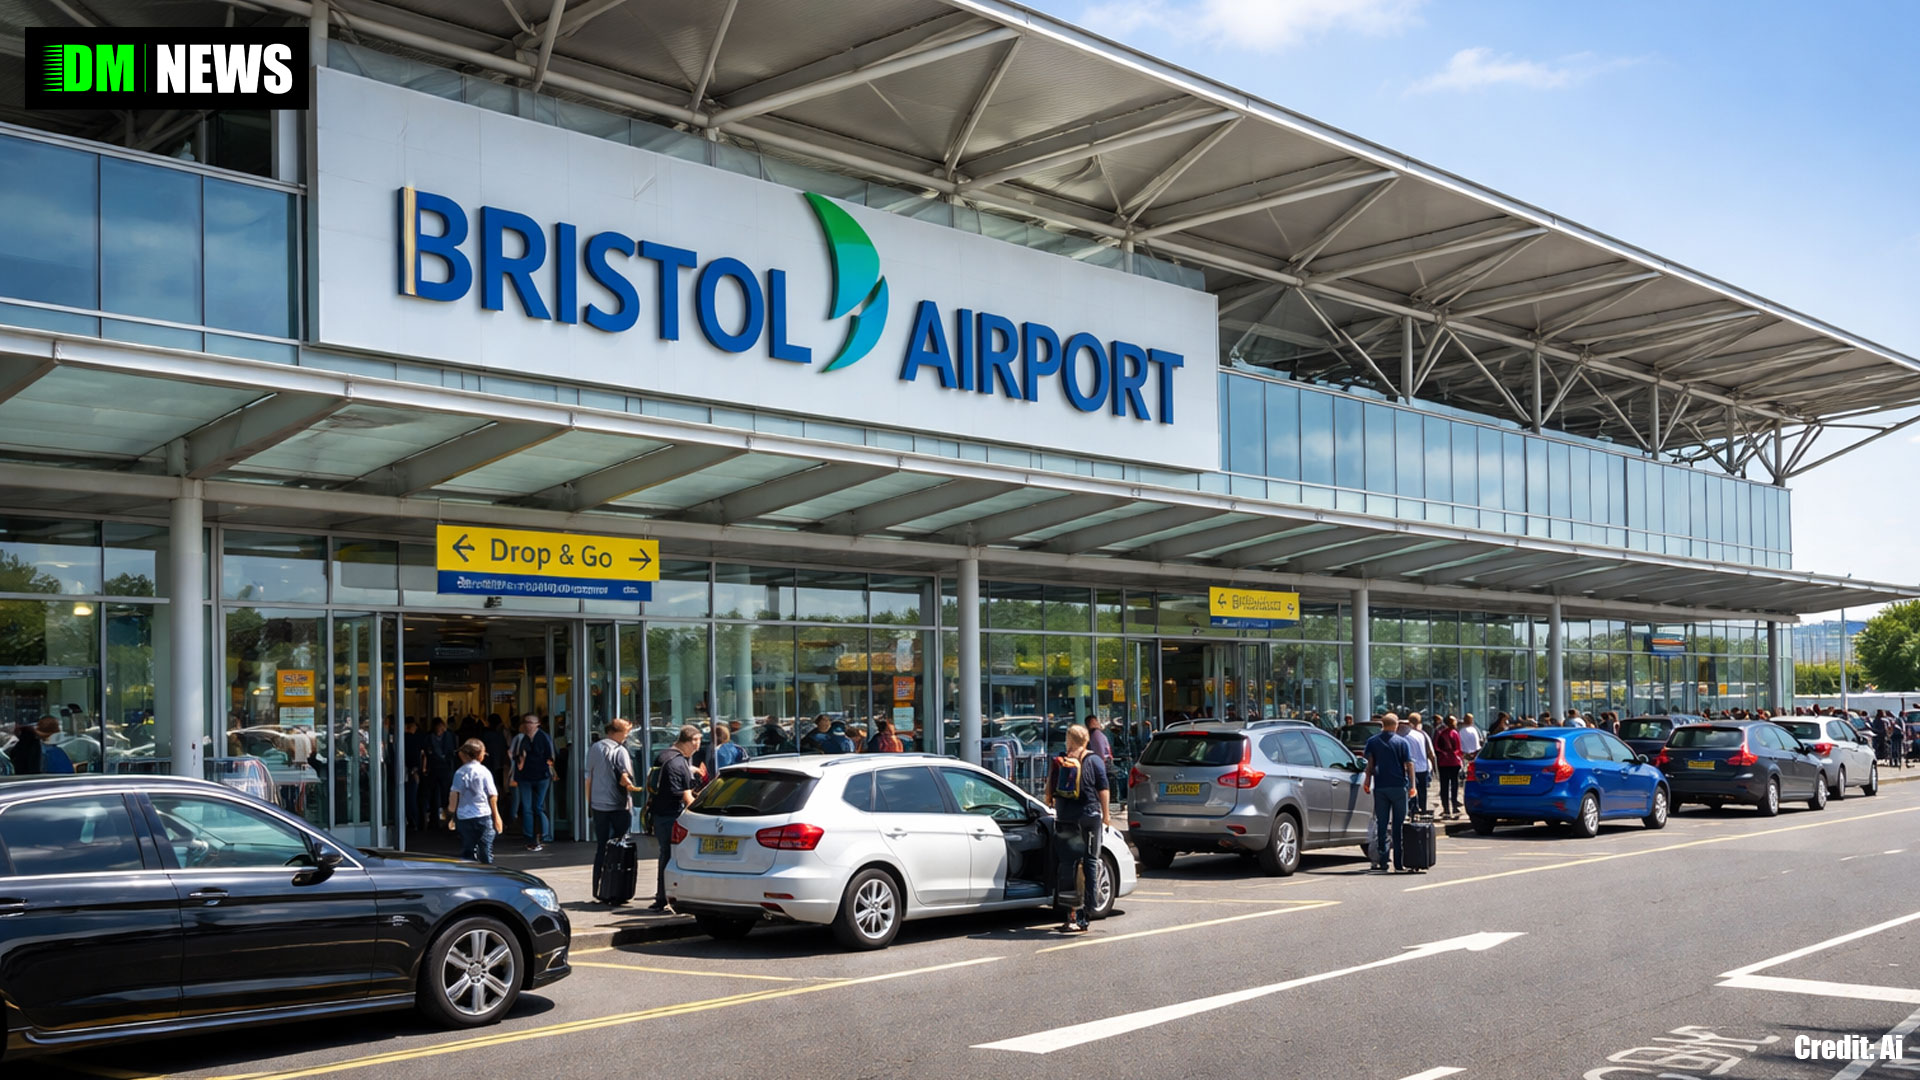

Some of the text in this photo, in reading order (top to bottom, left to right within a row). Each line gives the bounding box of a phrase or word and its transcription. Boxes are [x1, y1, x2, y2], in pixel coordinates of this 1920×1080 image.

[397, 186, 1185, 425] BRISTOL AIRPORT
[490, 538, 613, 570] Drop & Go
